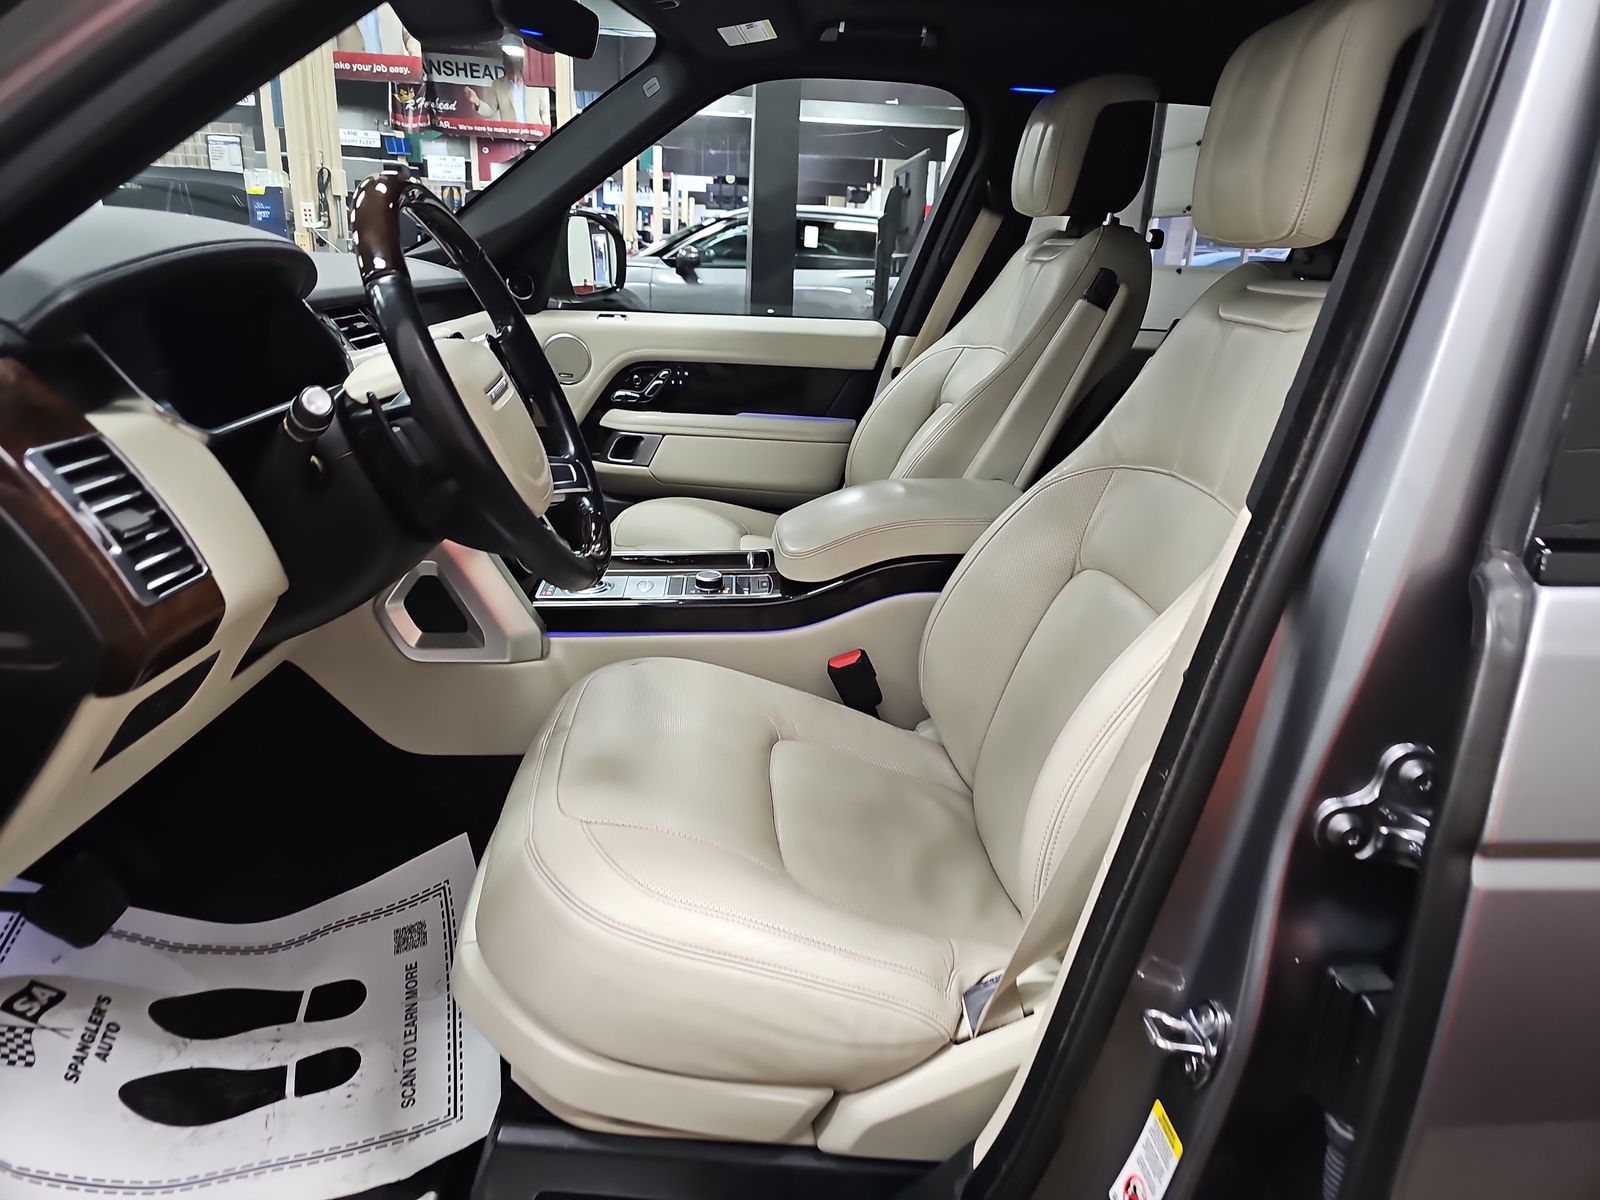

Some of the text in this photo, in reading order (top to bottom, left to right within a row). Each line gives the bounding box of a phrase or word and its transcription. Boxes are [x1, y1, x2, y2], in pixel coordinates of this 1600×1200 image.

[333, 62, 411, 75] ake your job easy.
[64, 994, 112, 1084] SPANGLER'S
[94, 1022, 121, 1063] AUTO
[401, 961, 418, 1109] SCAN TO LEARN MORE
